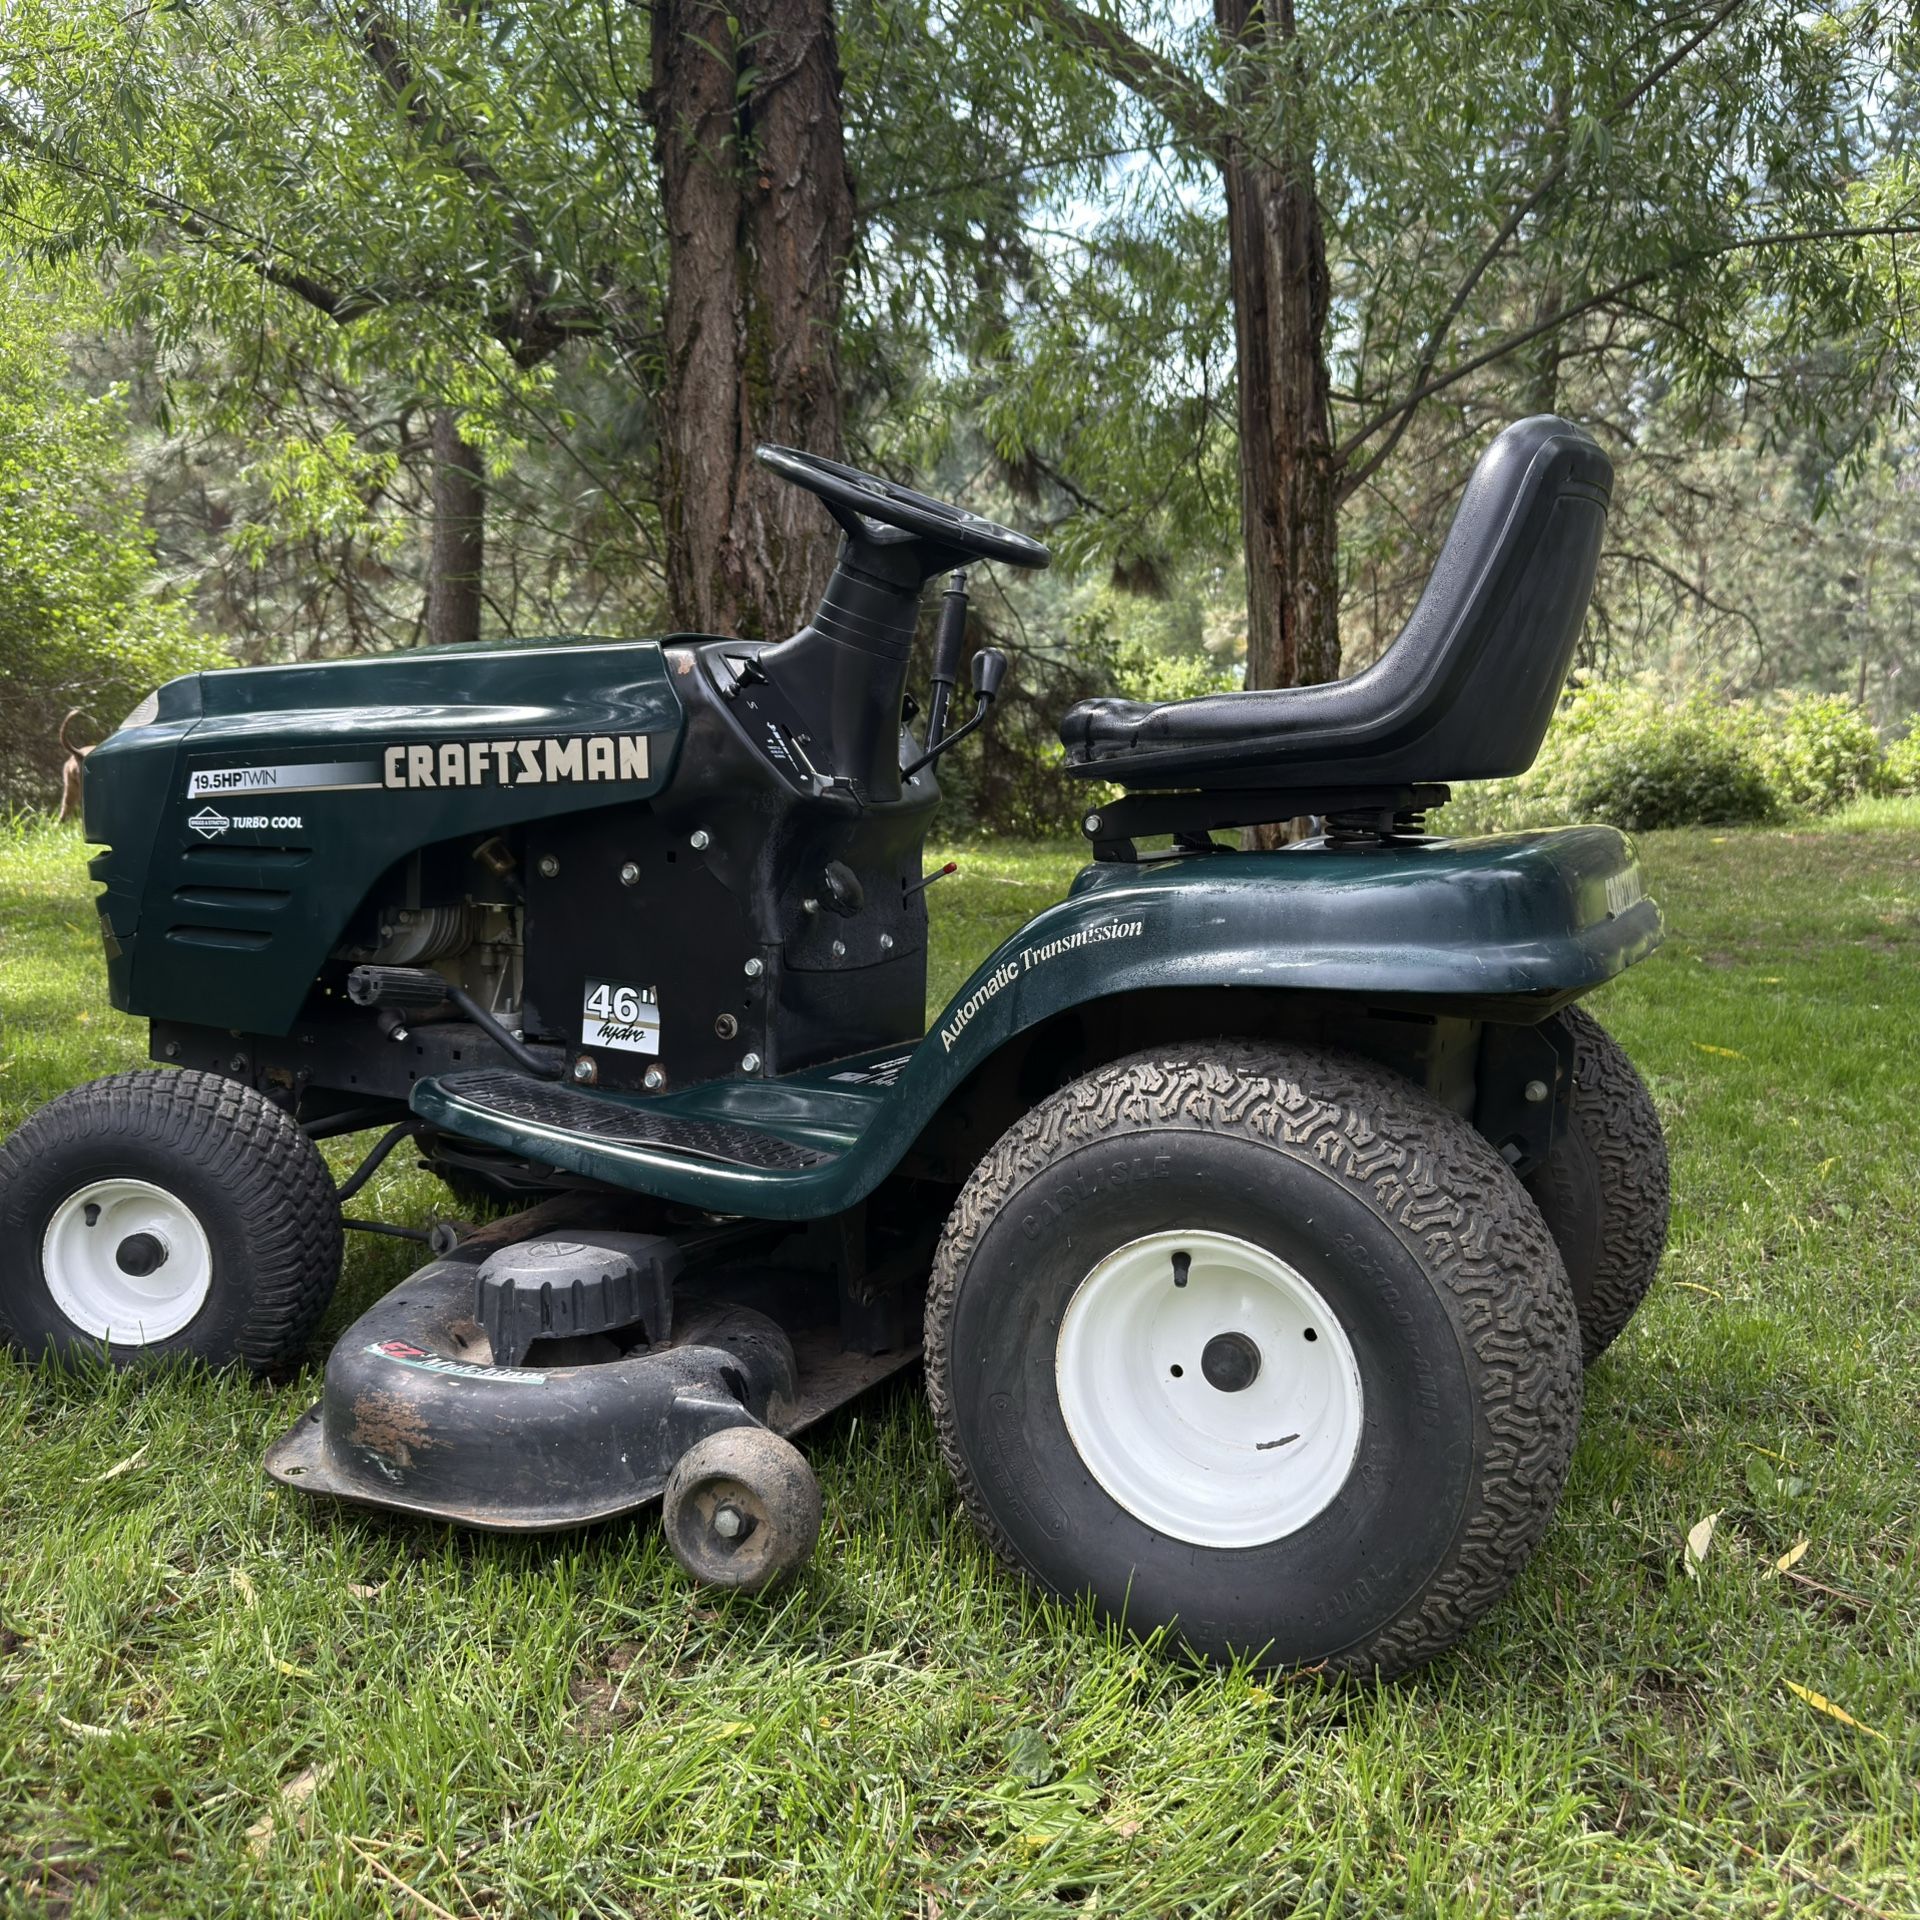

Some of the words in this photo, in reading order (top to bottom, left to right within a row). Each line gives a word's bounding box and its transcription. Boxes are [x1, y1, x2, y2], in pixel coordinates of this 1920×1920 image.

[384, 735, 649, 788] CRAFTSMAN
[232, 816, 268, 829] TURBO
[271, 816, 303, 829] COOL
[940, 961, 1019, 1053] Automatic
[1019, 918, 1143, 972] Transmission
[597, 1020, 647, 1046] hydro
[1020, 1154, 1172, 1241] CARLISLE
